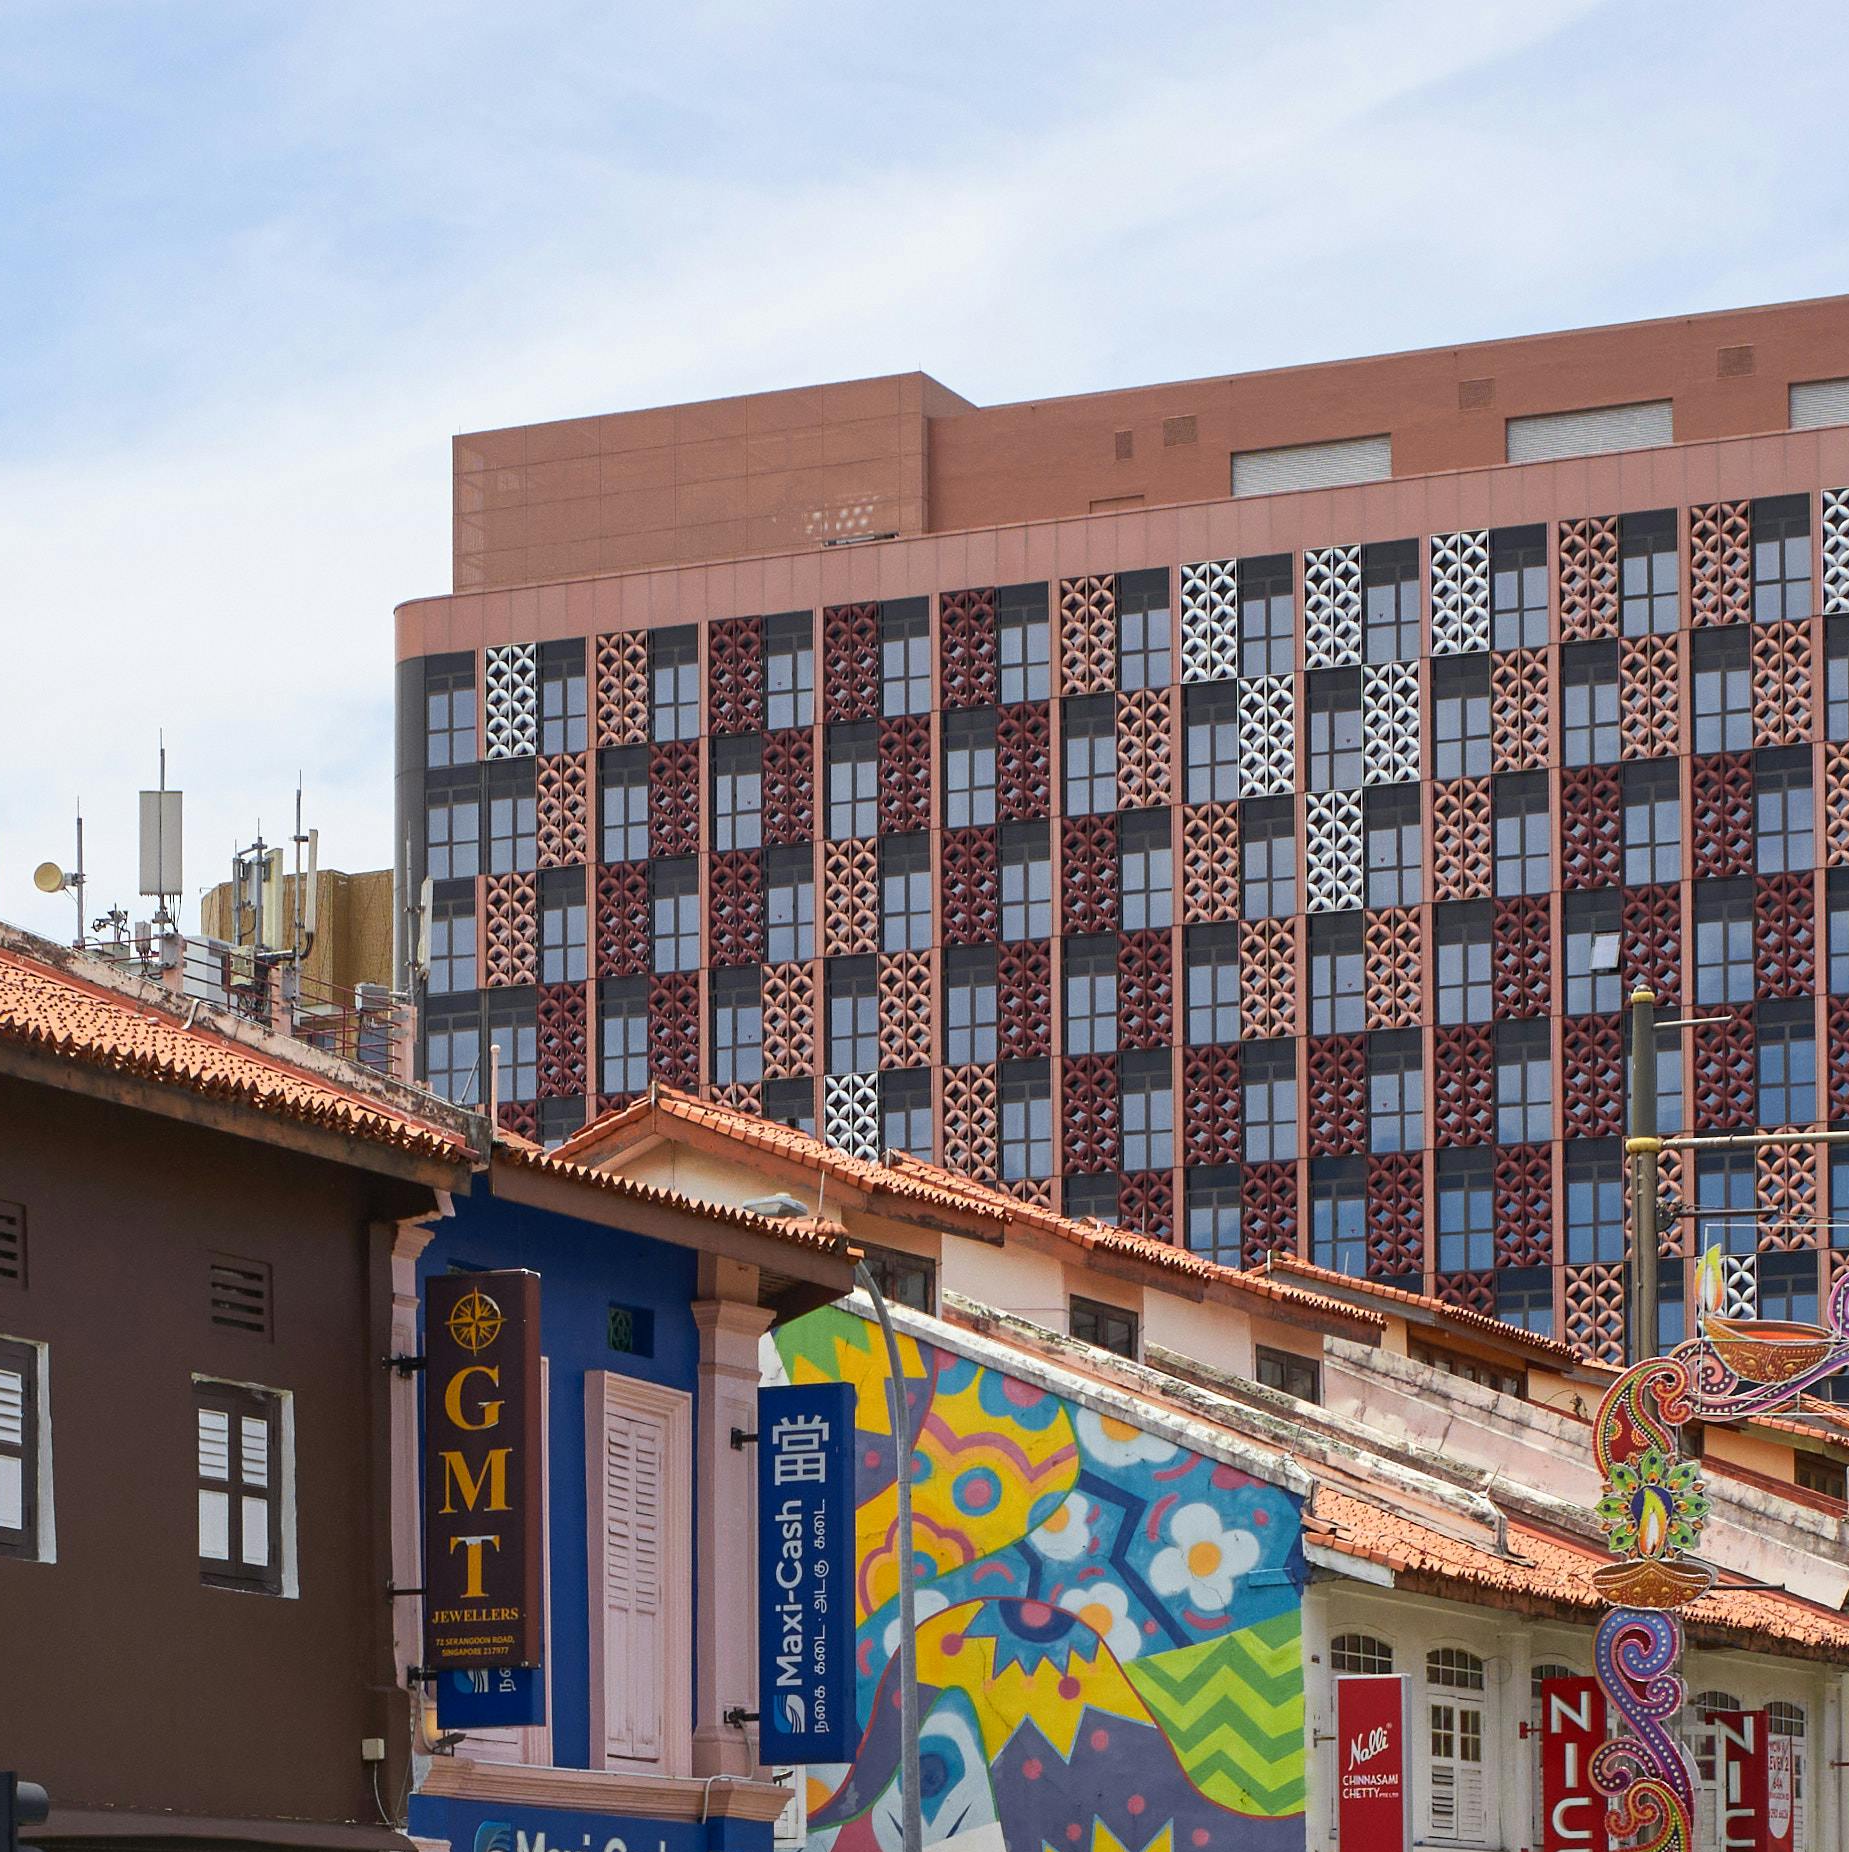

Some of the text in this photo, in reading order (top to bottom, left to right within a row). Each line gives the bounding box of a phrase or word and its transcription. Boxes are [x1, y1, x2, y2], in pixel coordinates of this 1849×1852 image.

[772, 1414, 830, 1486] 當
[438, 1366, 513, 1598] GMT
[775, 1499, 802, 1687] Maxi-Cash
[432, 1607, 519, 1624] JEWELLERS
[445, 1636, 490, 1646] SERANGOON
[1349, 1727, 1389, 1770] Nalli
[1343, 1774, 1399, 1787] CHINNASAMI
[1343, 1787, 1380, 1799] CHETTY
